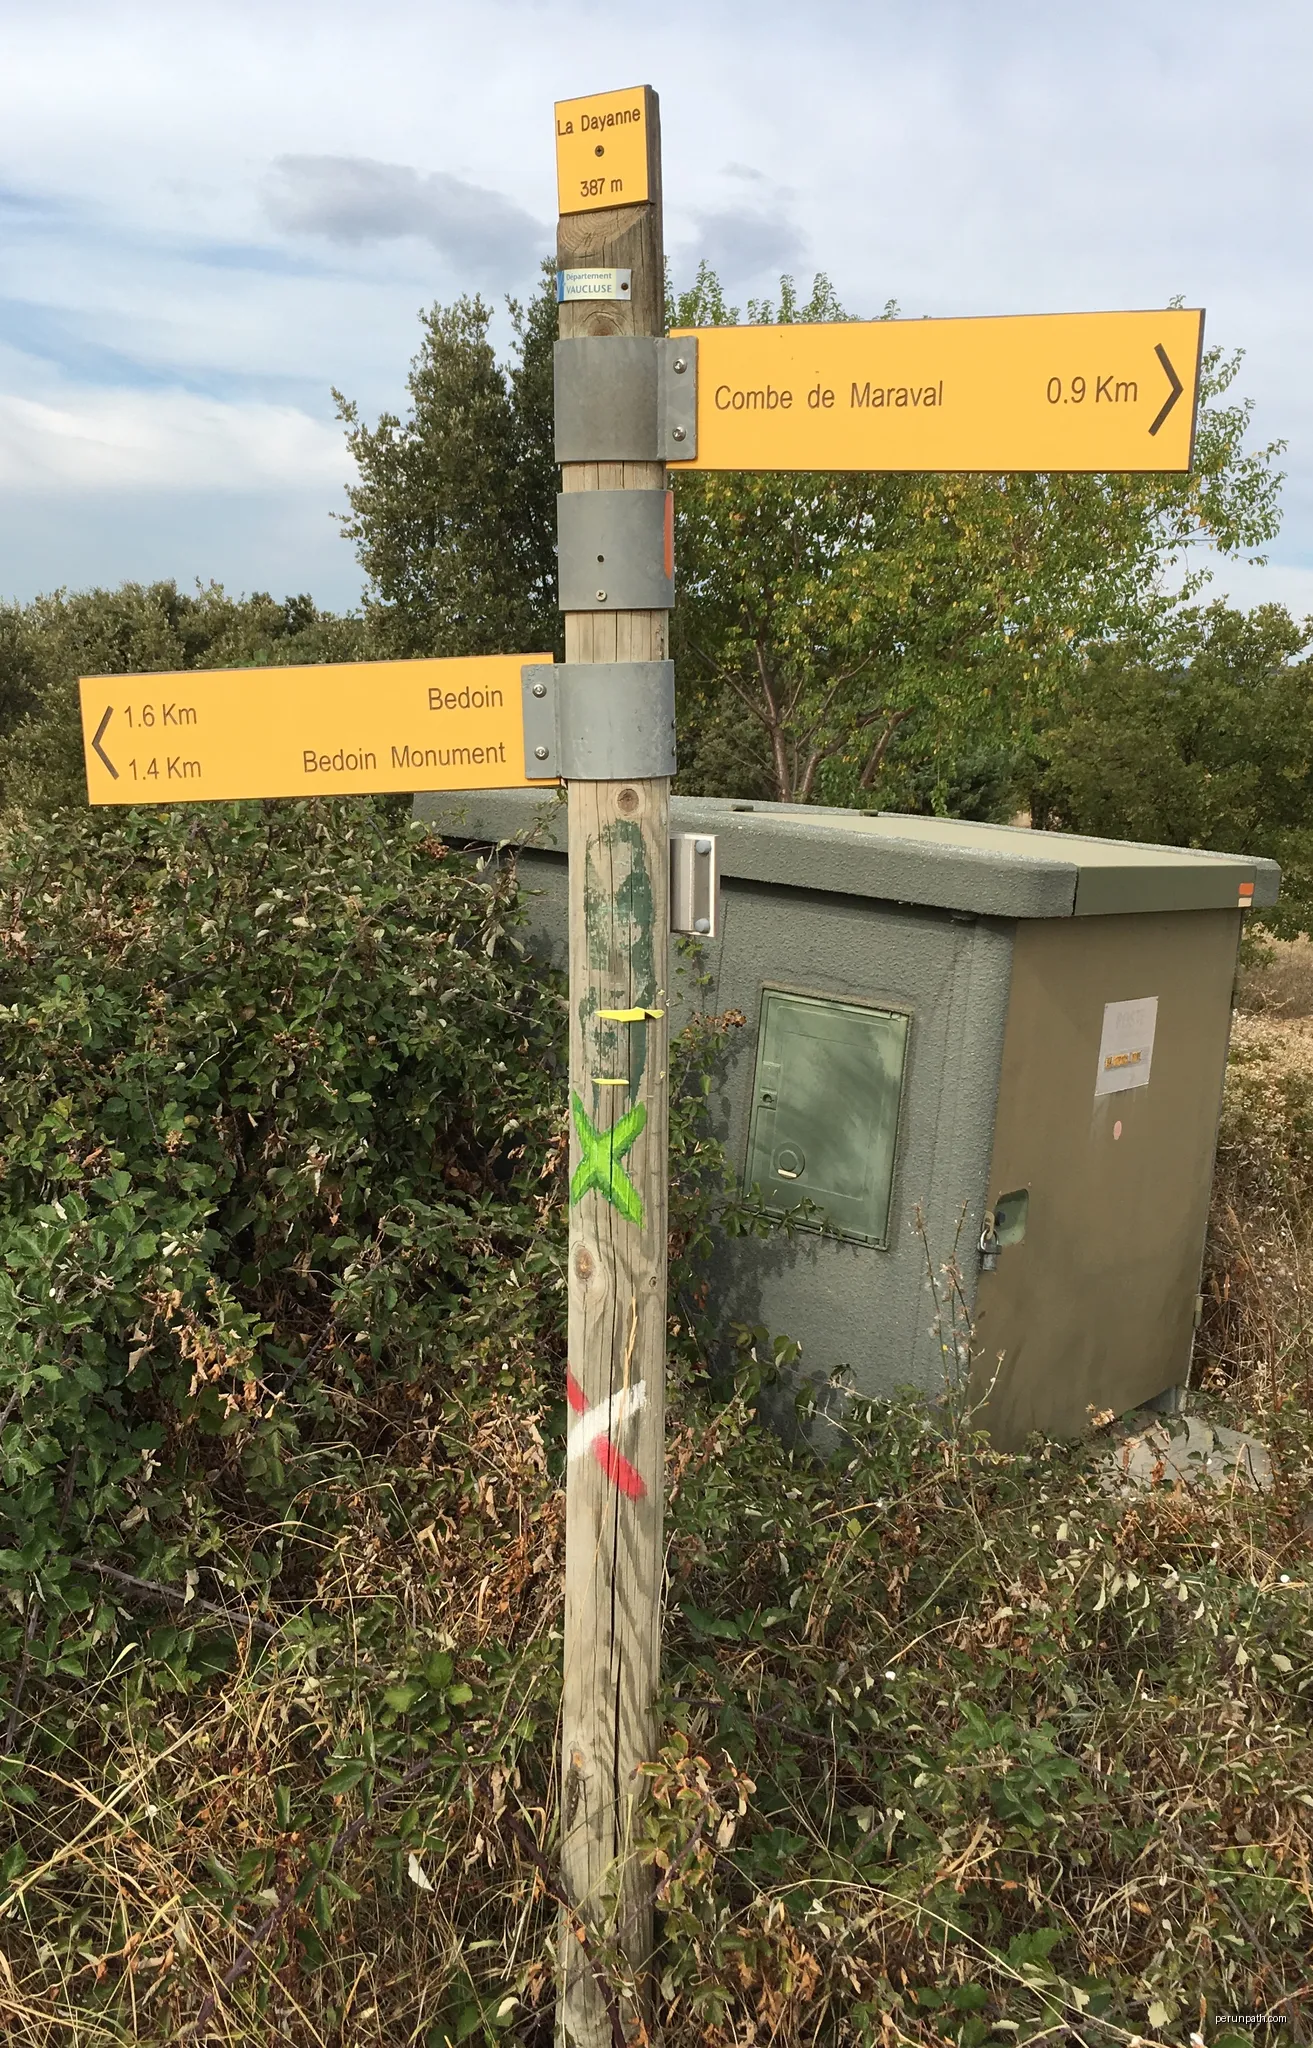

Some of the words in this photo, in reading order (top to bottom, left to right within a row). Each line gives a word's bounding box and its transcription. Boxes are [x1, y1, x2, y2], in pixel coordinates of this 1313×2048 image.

[557, 120, 574, 136] La
[581, 108, 641, 132] Dayanne
[580, 178, 605, 197] 387
[610, 178, 623, 192] m
[566, 273, 612, 281] Département
[566, 285, 612, 294] VAUCLUSE
[715, 385, 793, 410] Combe
[807, 384, 835, 409] de
[850, 380, 943, 408] Maraval
[1046, 376, 1086, 404] 0.9
[1095, 375, 1138, 403] Km
[124, 704, 155, 728] 1.6
[162, 703, 197, 726] Km
[428, 685, 503, 710] Bedoin
[128, 757, 160, 781] 1.4
[167, 756, 202, 779] Km
[303, 748, 377, 773] Bedoin
[391, 742, 506, 769] Monument
